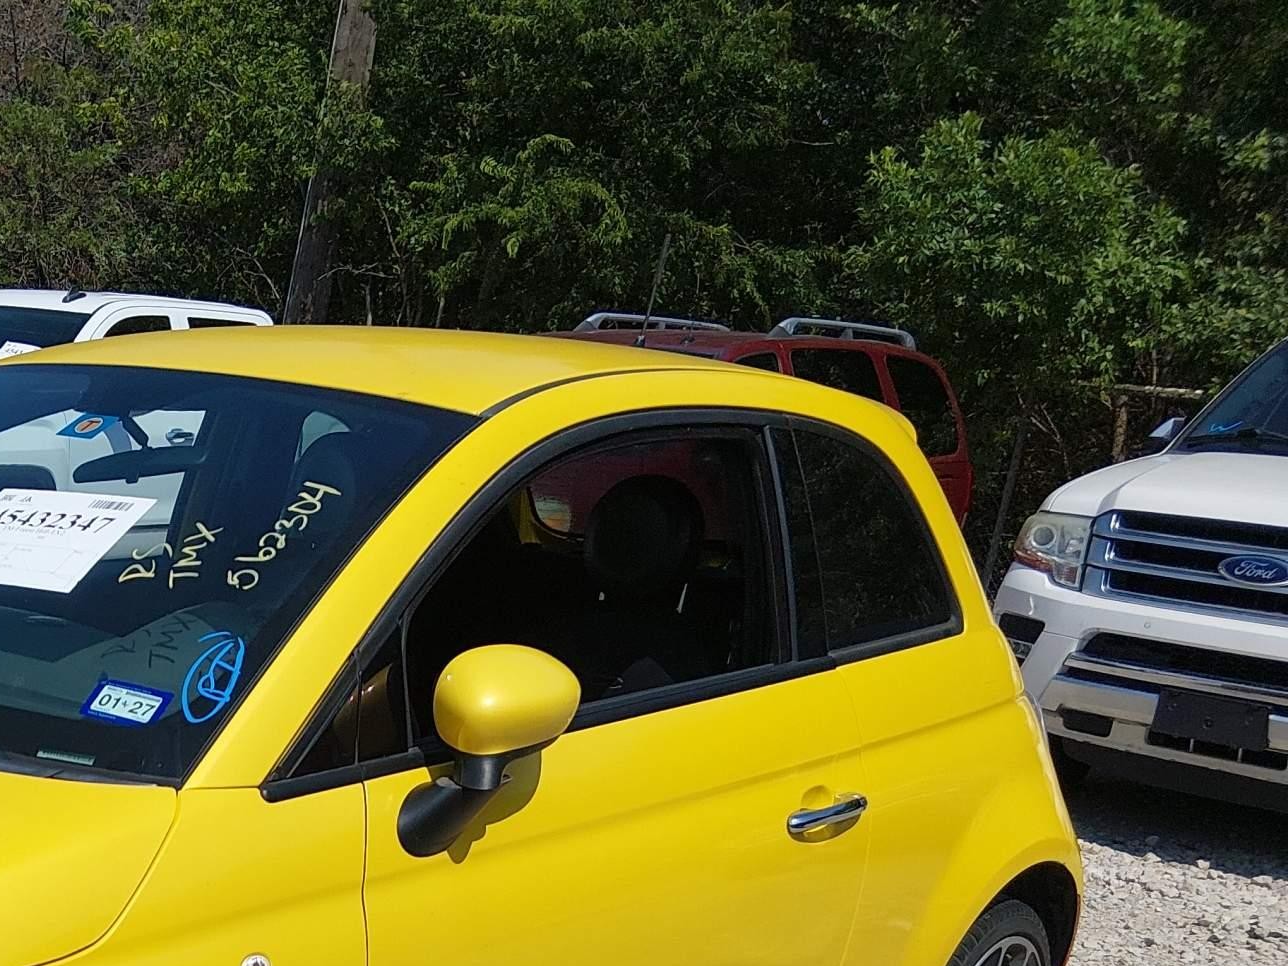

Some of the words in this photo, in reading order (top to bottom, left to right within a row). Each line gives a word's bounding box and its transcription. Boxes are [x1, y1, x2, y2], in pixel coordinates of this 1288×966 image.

[168, 521, 224, 590] TMX
[1234, 560, 1278, 580] Ford
[98, 693, 122, 709] 01
[127, 701, 156, 716] 27
